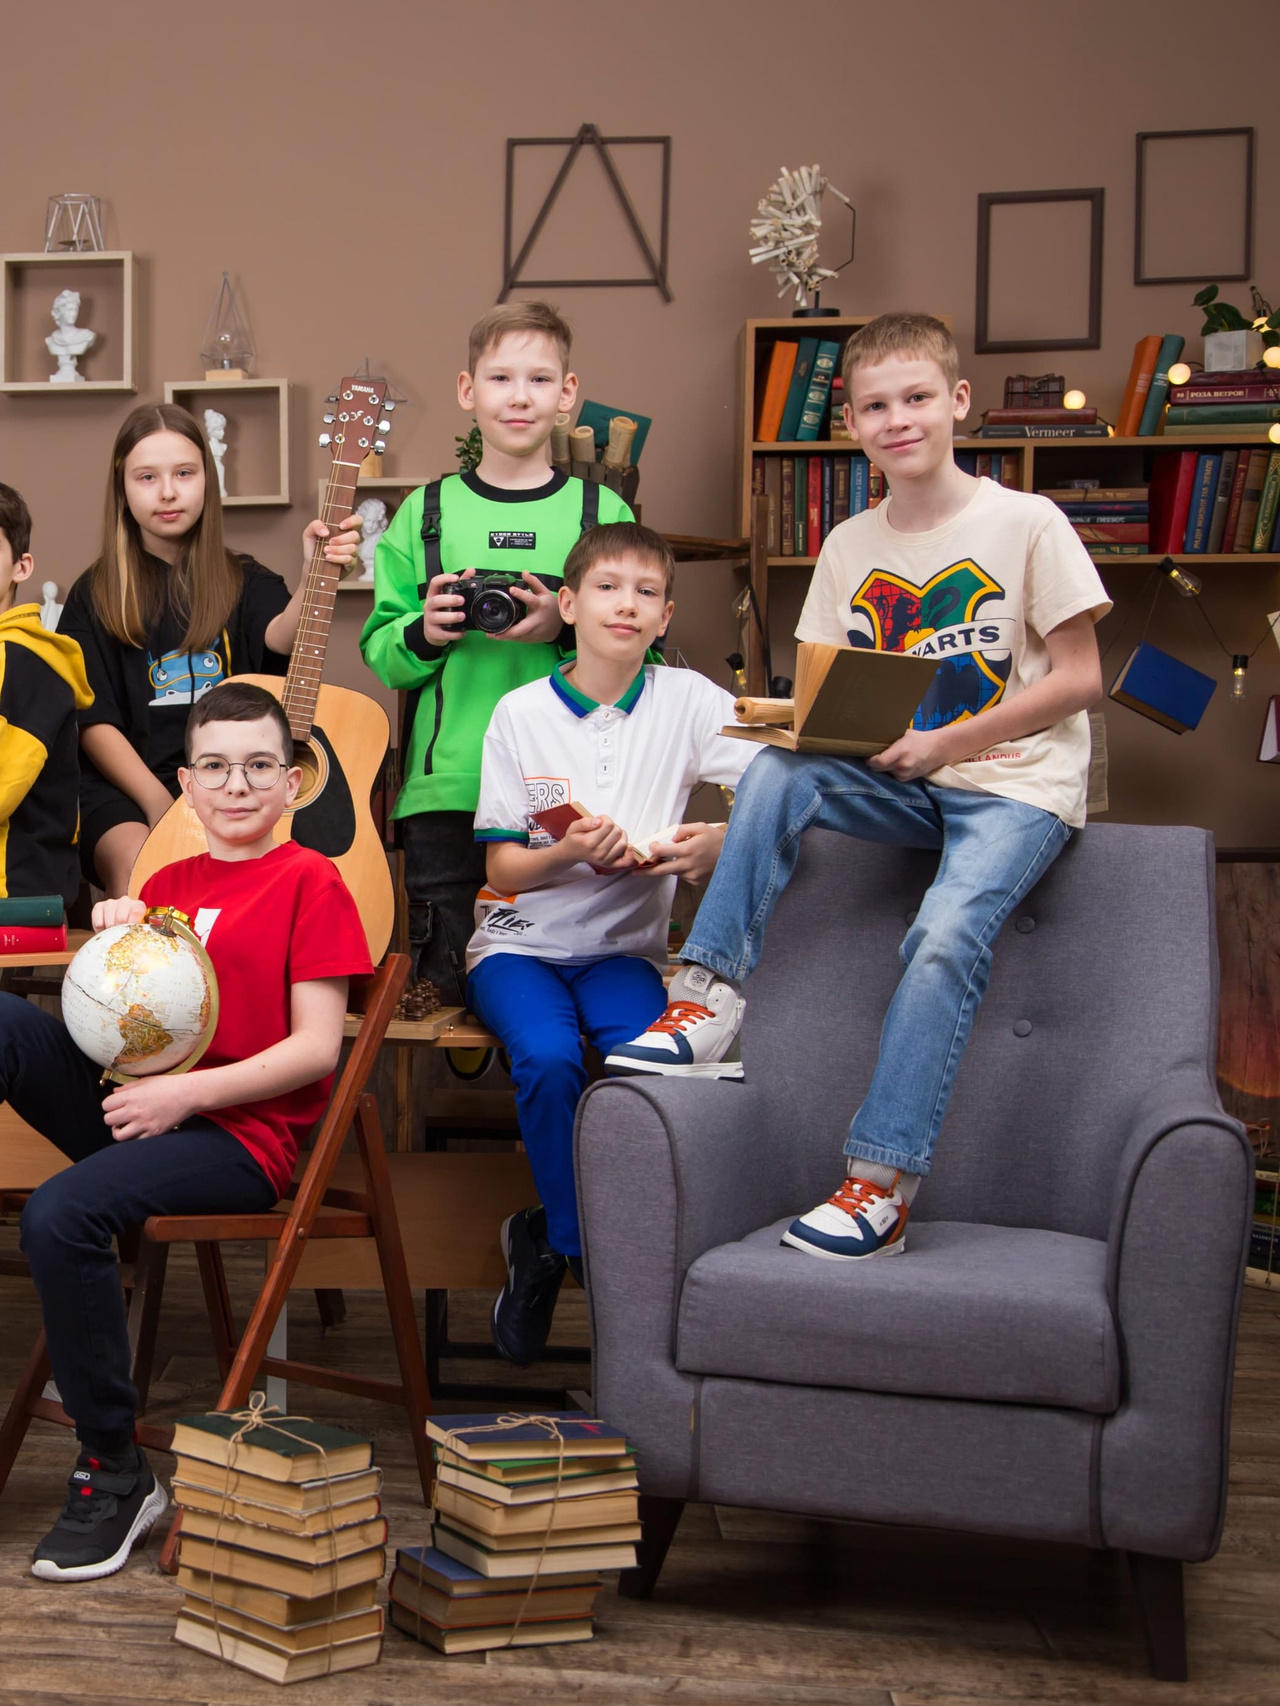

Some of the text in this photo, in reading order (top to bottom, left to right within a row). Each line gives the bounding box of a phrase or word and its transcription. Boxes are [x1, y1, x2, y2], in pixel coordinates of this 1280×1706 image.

[351, 384, 374, 393] YAMAHA
[1190, 389, 1245, 399] РОЗА ВЕТРОВ
[1024, 426, 1076, 438] Vermeer
